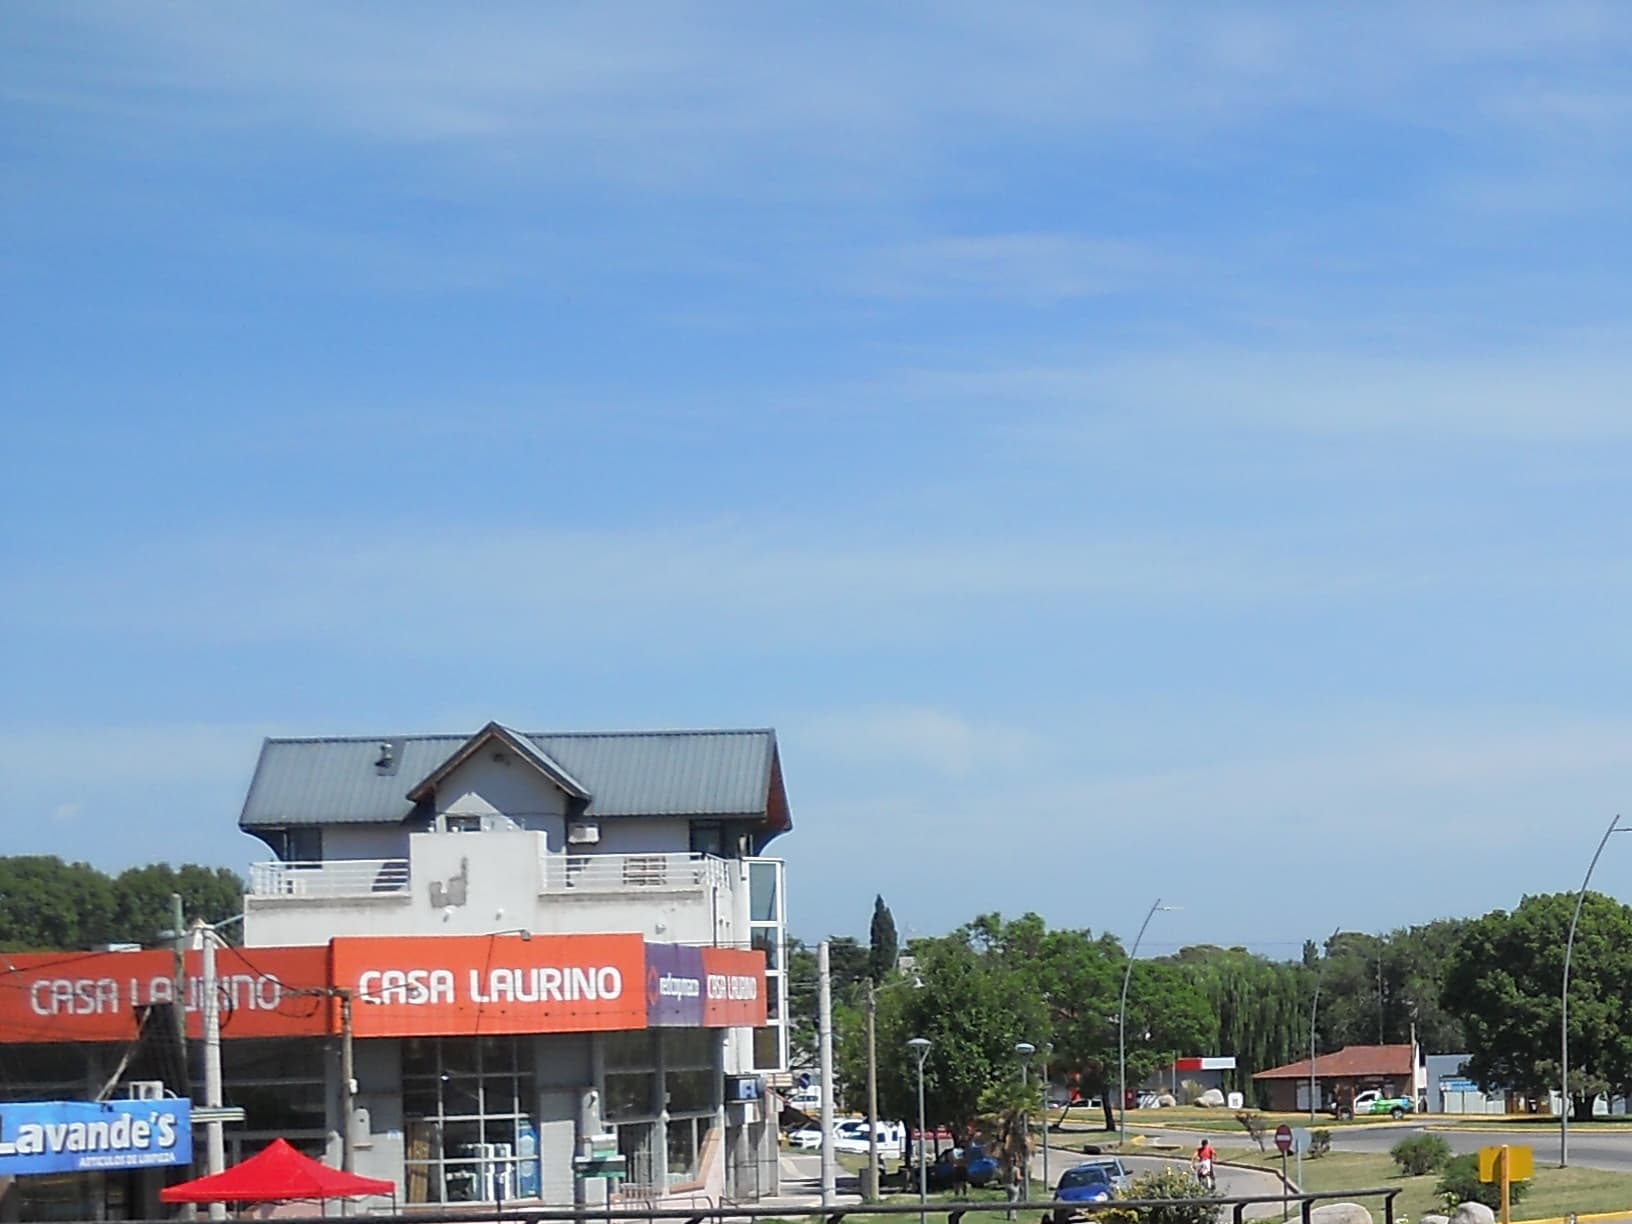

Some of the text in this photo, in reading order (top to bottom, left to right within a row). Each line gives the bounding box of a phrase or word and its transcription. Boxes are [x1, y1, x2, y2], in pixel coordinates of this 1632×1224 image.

[31, 974, 282, 1015] CASA LAUINO
[358, 970, 454, 1004] CASA
[470, 967, 621, 1002] LAURINO
